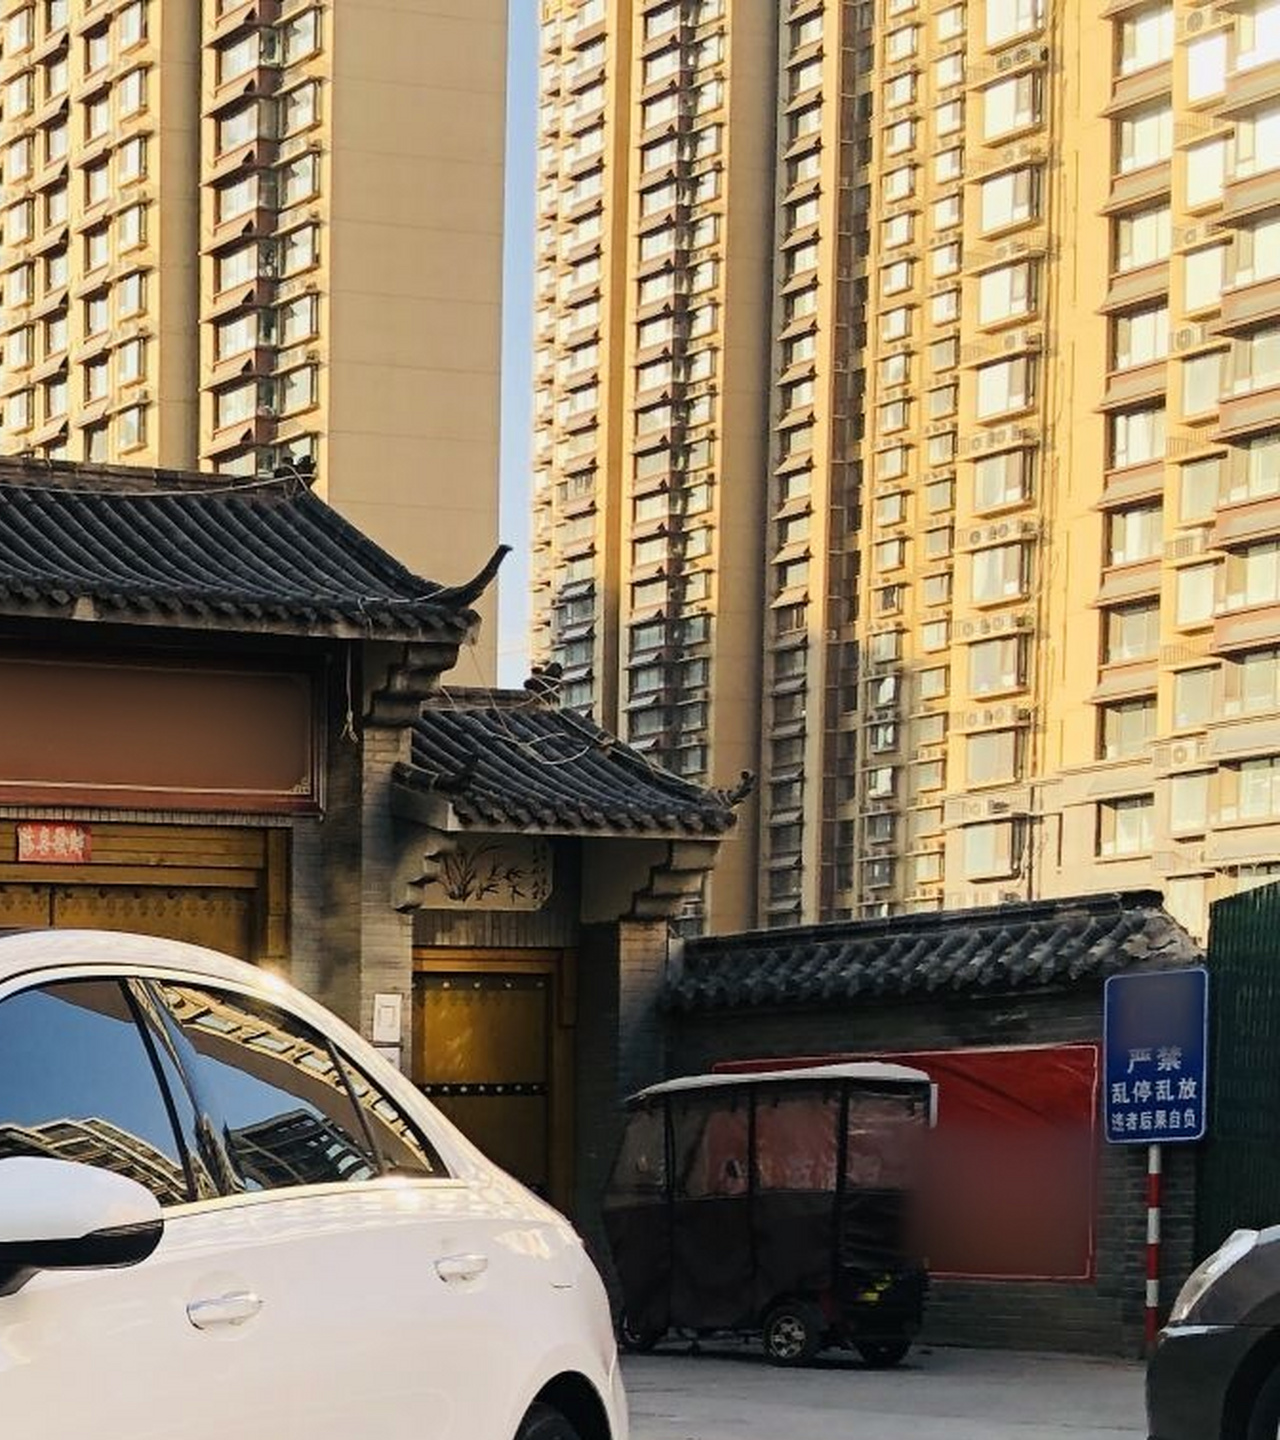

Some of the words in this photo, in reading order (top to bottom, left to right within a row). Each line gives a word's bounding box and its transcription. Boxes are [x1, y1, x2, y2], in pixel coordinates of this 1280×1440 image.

[1127, 1046, 1182, 1074] 严禁
[1111, 1077, 1197, 1104] 乱停乱放
[1111, 1108, 1196, 1132] 违者后果自负
